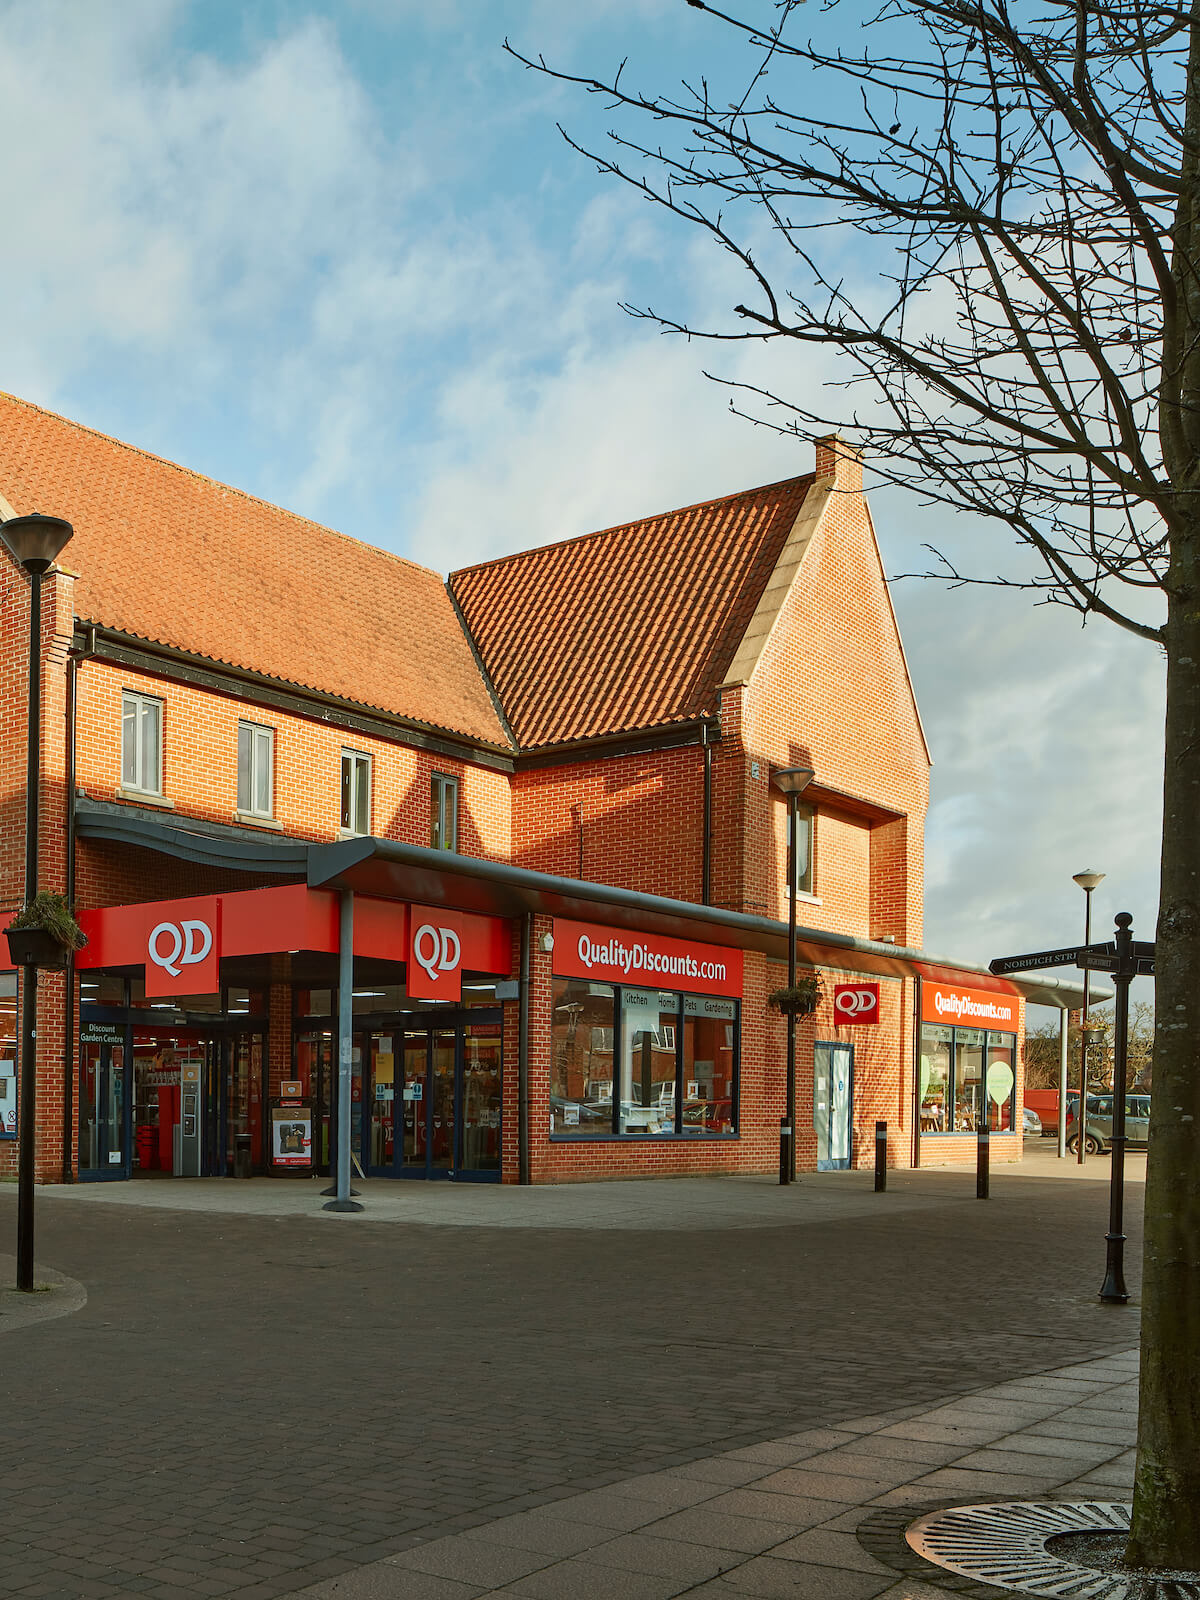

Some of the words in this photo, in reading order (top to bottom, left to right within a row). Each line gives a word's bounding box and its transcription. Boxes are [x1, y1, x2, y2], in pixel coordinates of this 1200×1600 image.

[148, 919, 213, 977] QD
[414, 924, 461, 981] QD
[578, 935, 727, 981] QualityDiscounts.com
[1004, 957, 1053, 970] NORWICH
[835, 990, 877, 1018] QD
[934, 991, 1012, 1021] QualityDiscounts.com
[80, 1033, 102, 1043] Garden
[102, 1034, 124, 1044] Centre
[88, 1023, 116, 1034] Discount
